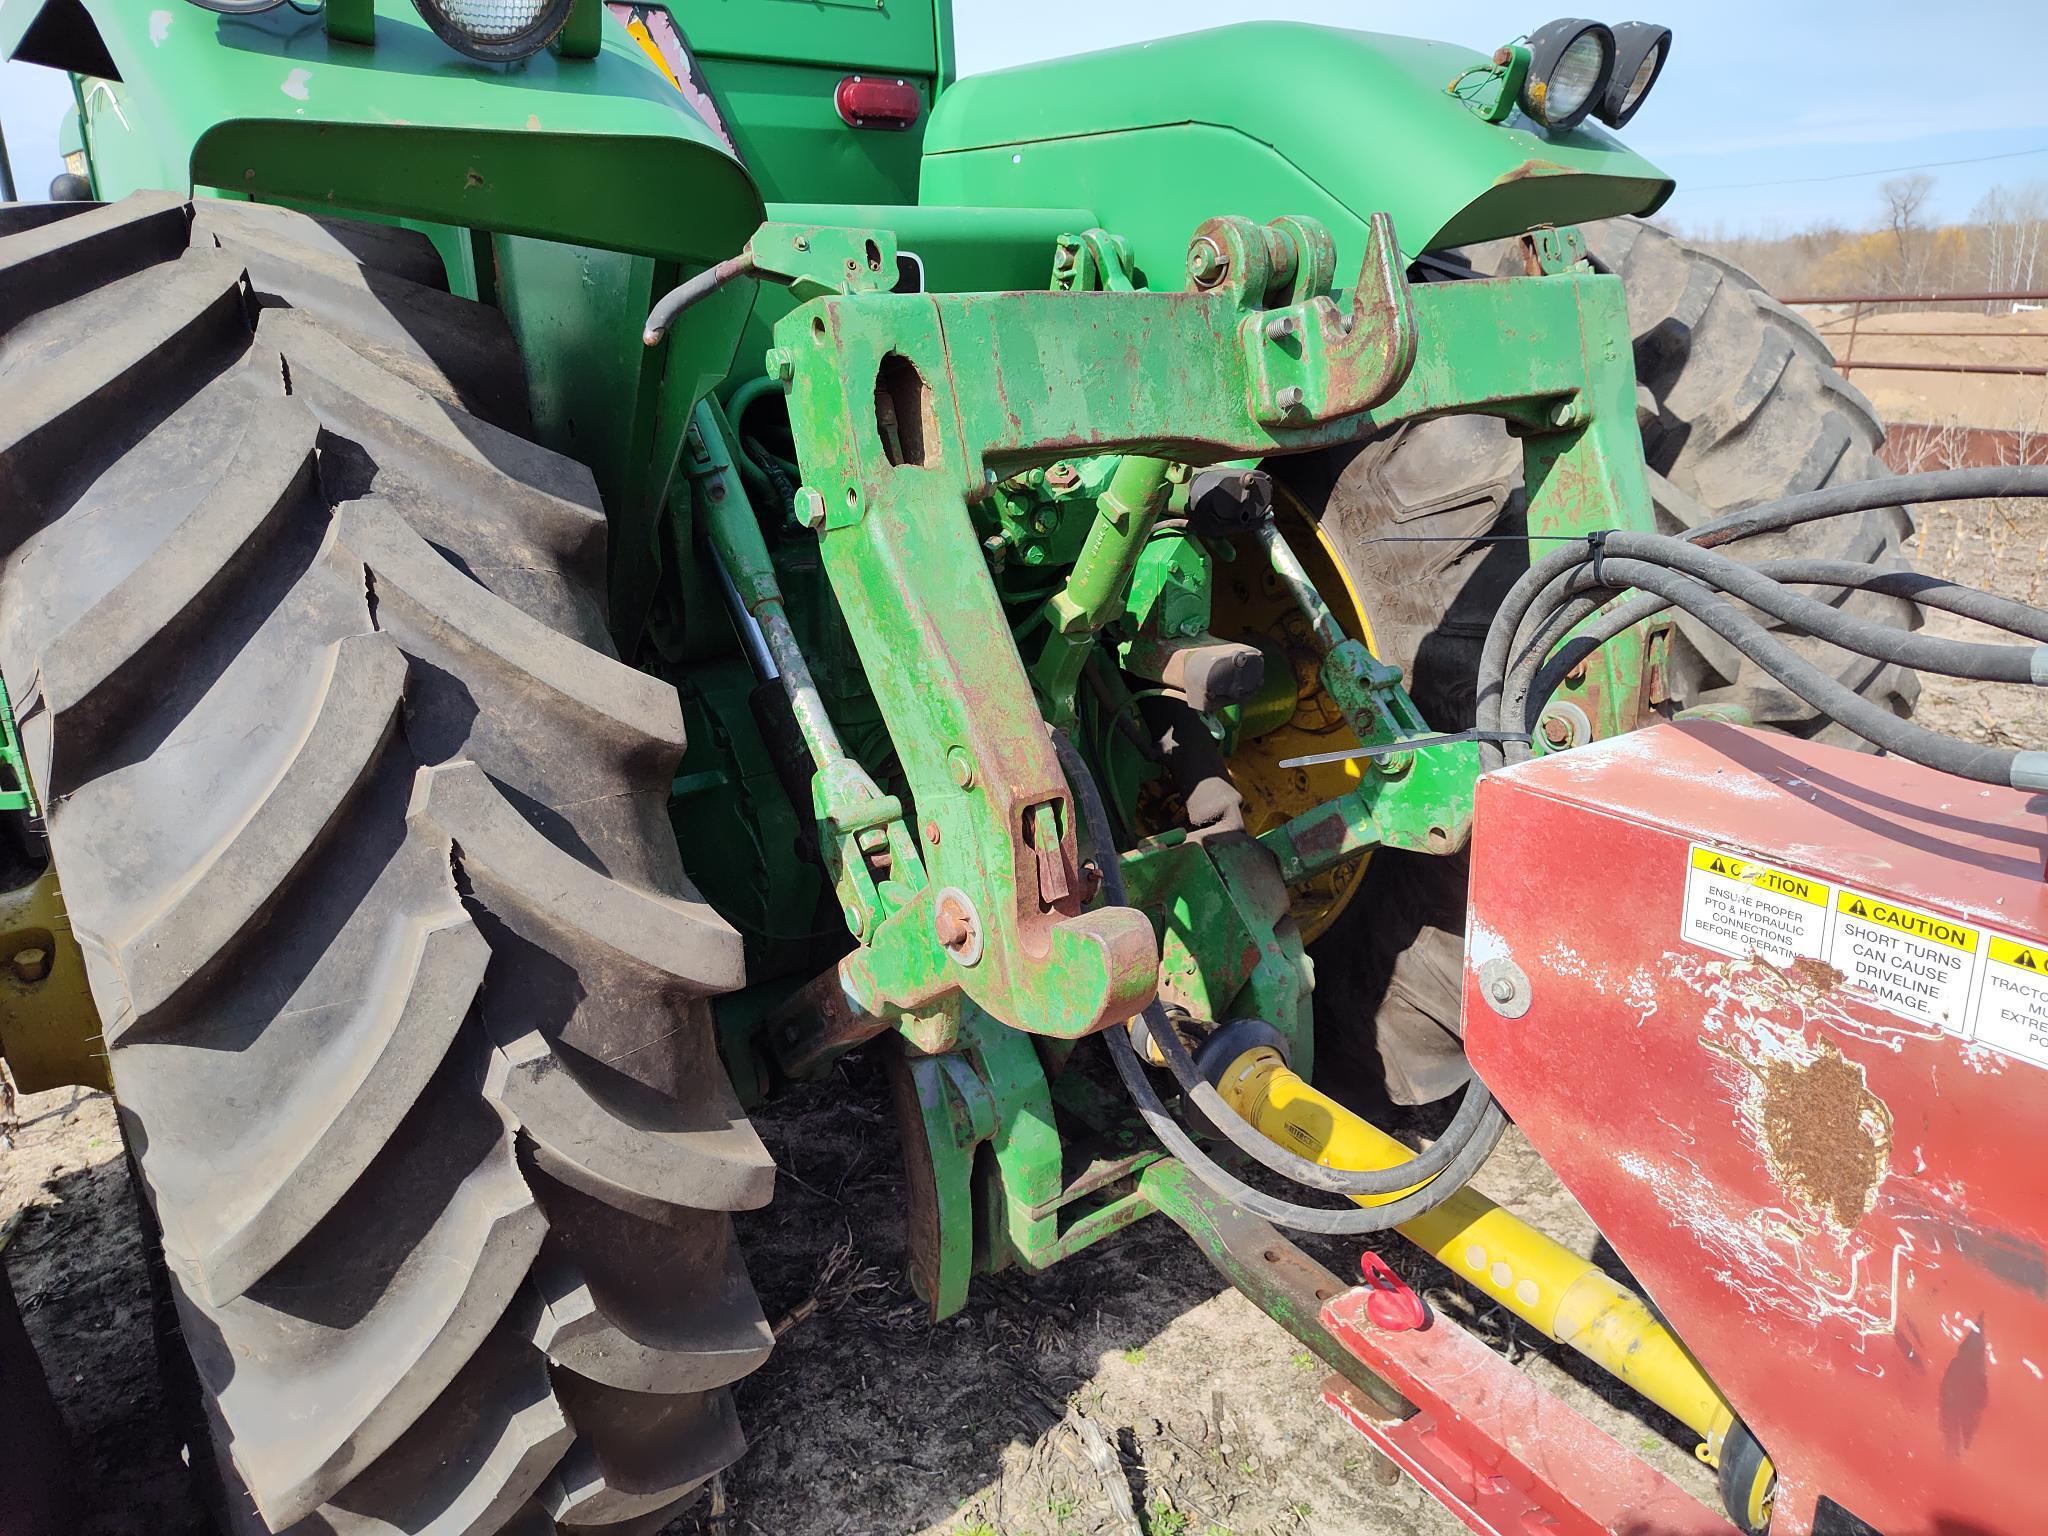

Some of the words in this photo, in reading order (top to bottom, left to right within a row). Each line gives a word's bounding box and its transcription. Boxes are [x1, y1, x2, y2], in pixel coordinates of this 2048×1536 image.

[1730, 863, 1809, 898] CTION
[1705, 897, 1727, 911] PTO
[1728, 905, 1736, 914] &
[1739, 908, 1804, 936] HYDRAULIC
[1709, 886, 1753, 907] ENSURE
[1755, 901, 1803, 923] PROPER
[1695, 920, 1738, 940] BEFORE
[1712, 912, 1793, 946] CONNECTIONS
[1873, 907, 1966, 946] CAUTION
[1844, 923, 1900, 949] SHORT
[1904, 941, 1961, 970] TURNS
[1853, 943, 1887, 964] CAN
[1891, 956, 1949, 984] CAUSE
[1855, 961, 1941, 999] DRIVELINE
[2001, 1008, 2048, 1033] EXTRE
